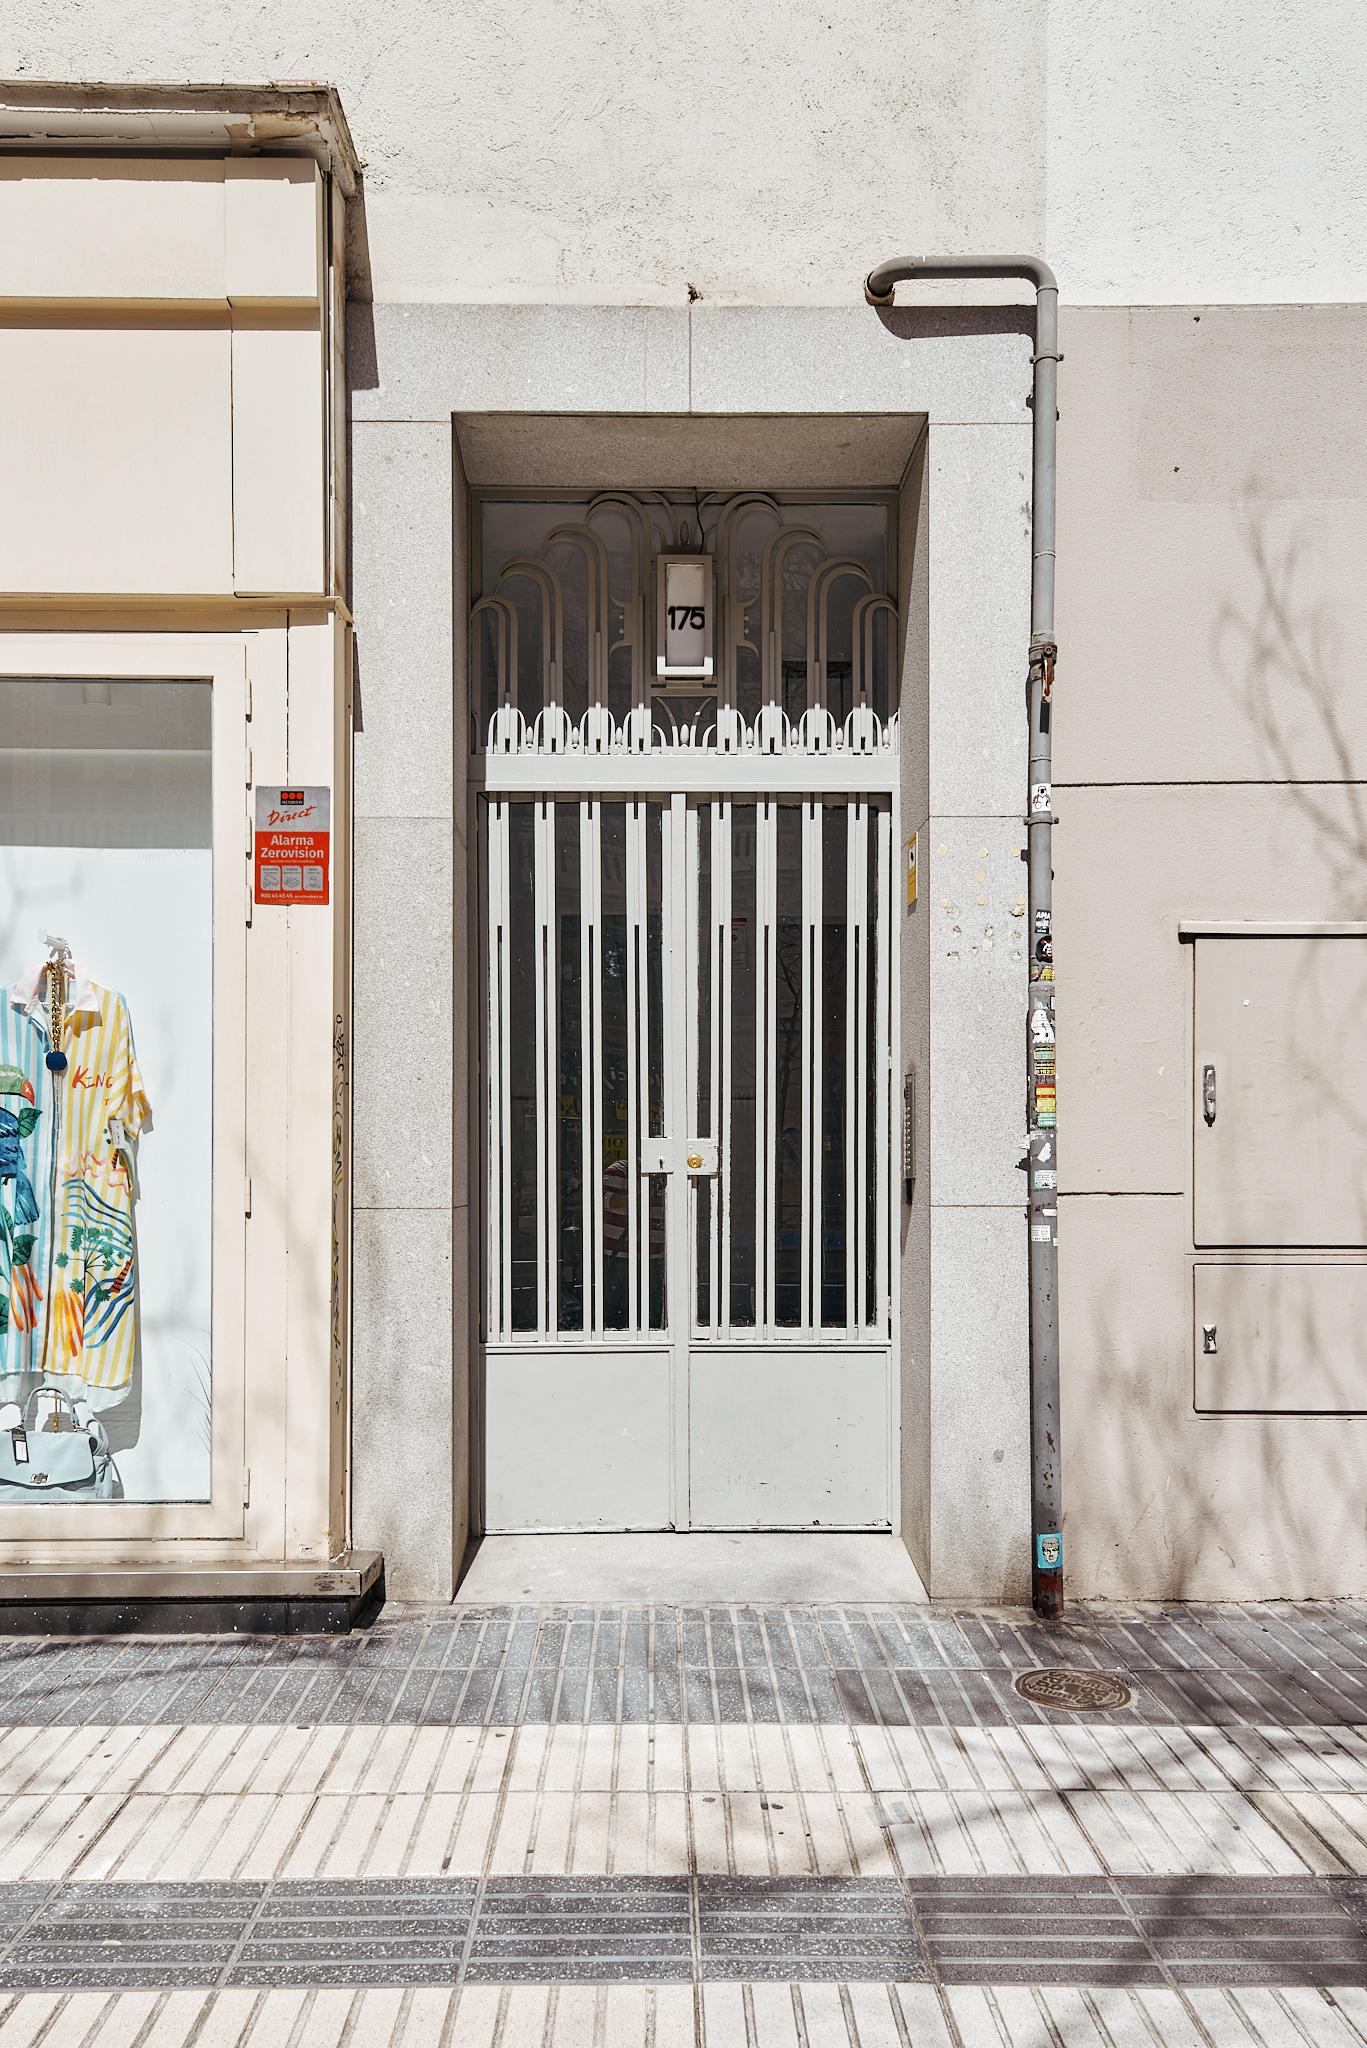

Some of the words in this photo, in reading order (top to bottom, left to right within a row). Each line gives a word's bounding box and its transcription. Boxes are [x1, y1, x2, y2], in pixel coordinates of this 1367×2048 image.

[667, 605, 705, 631] 175
[267, 805, 318, 826] Direct
[271, 835, 314, 846] Alarma
[260, 846, 324, 859] Zerovision
